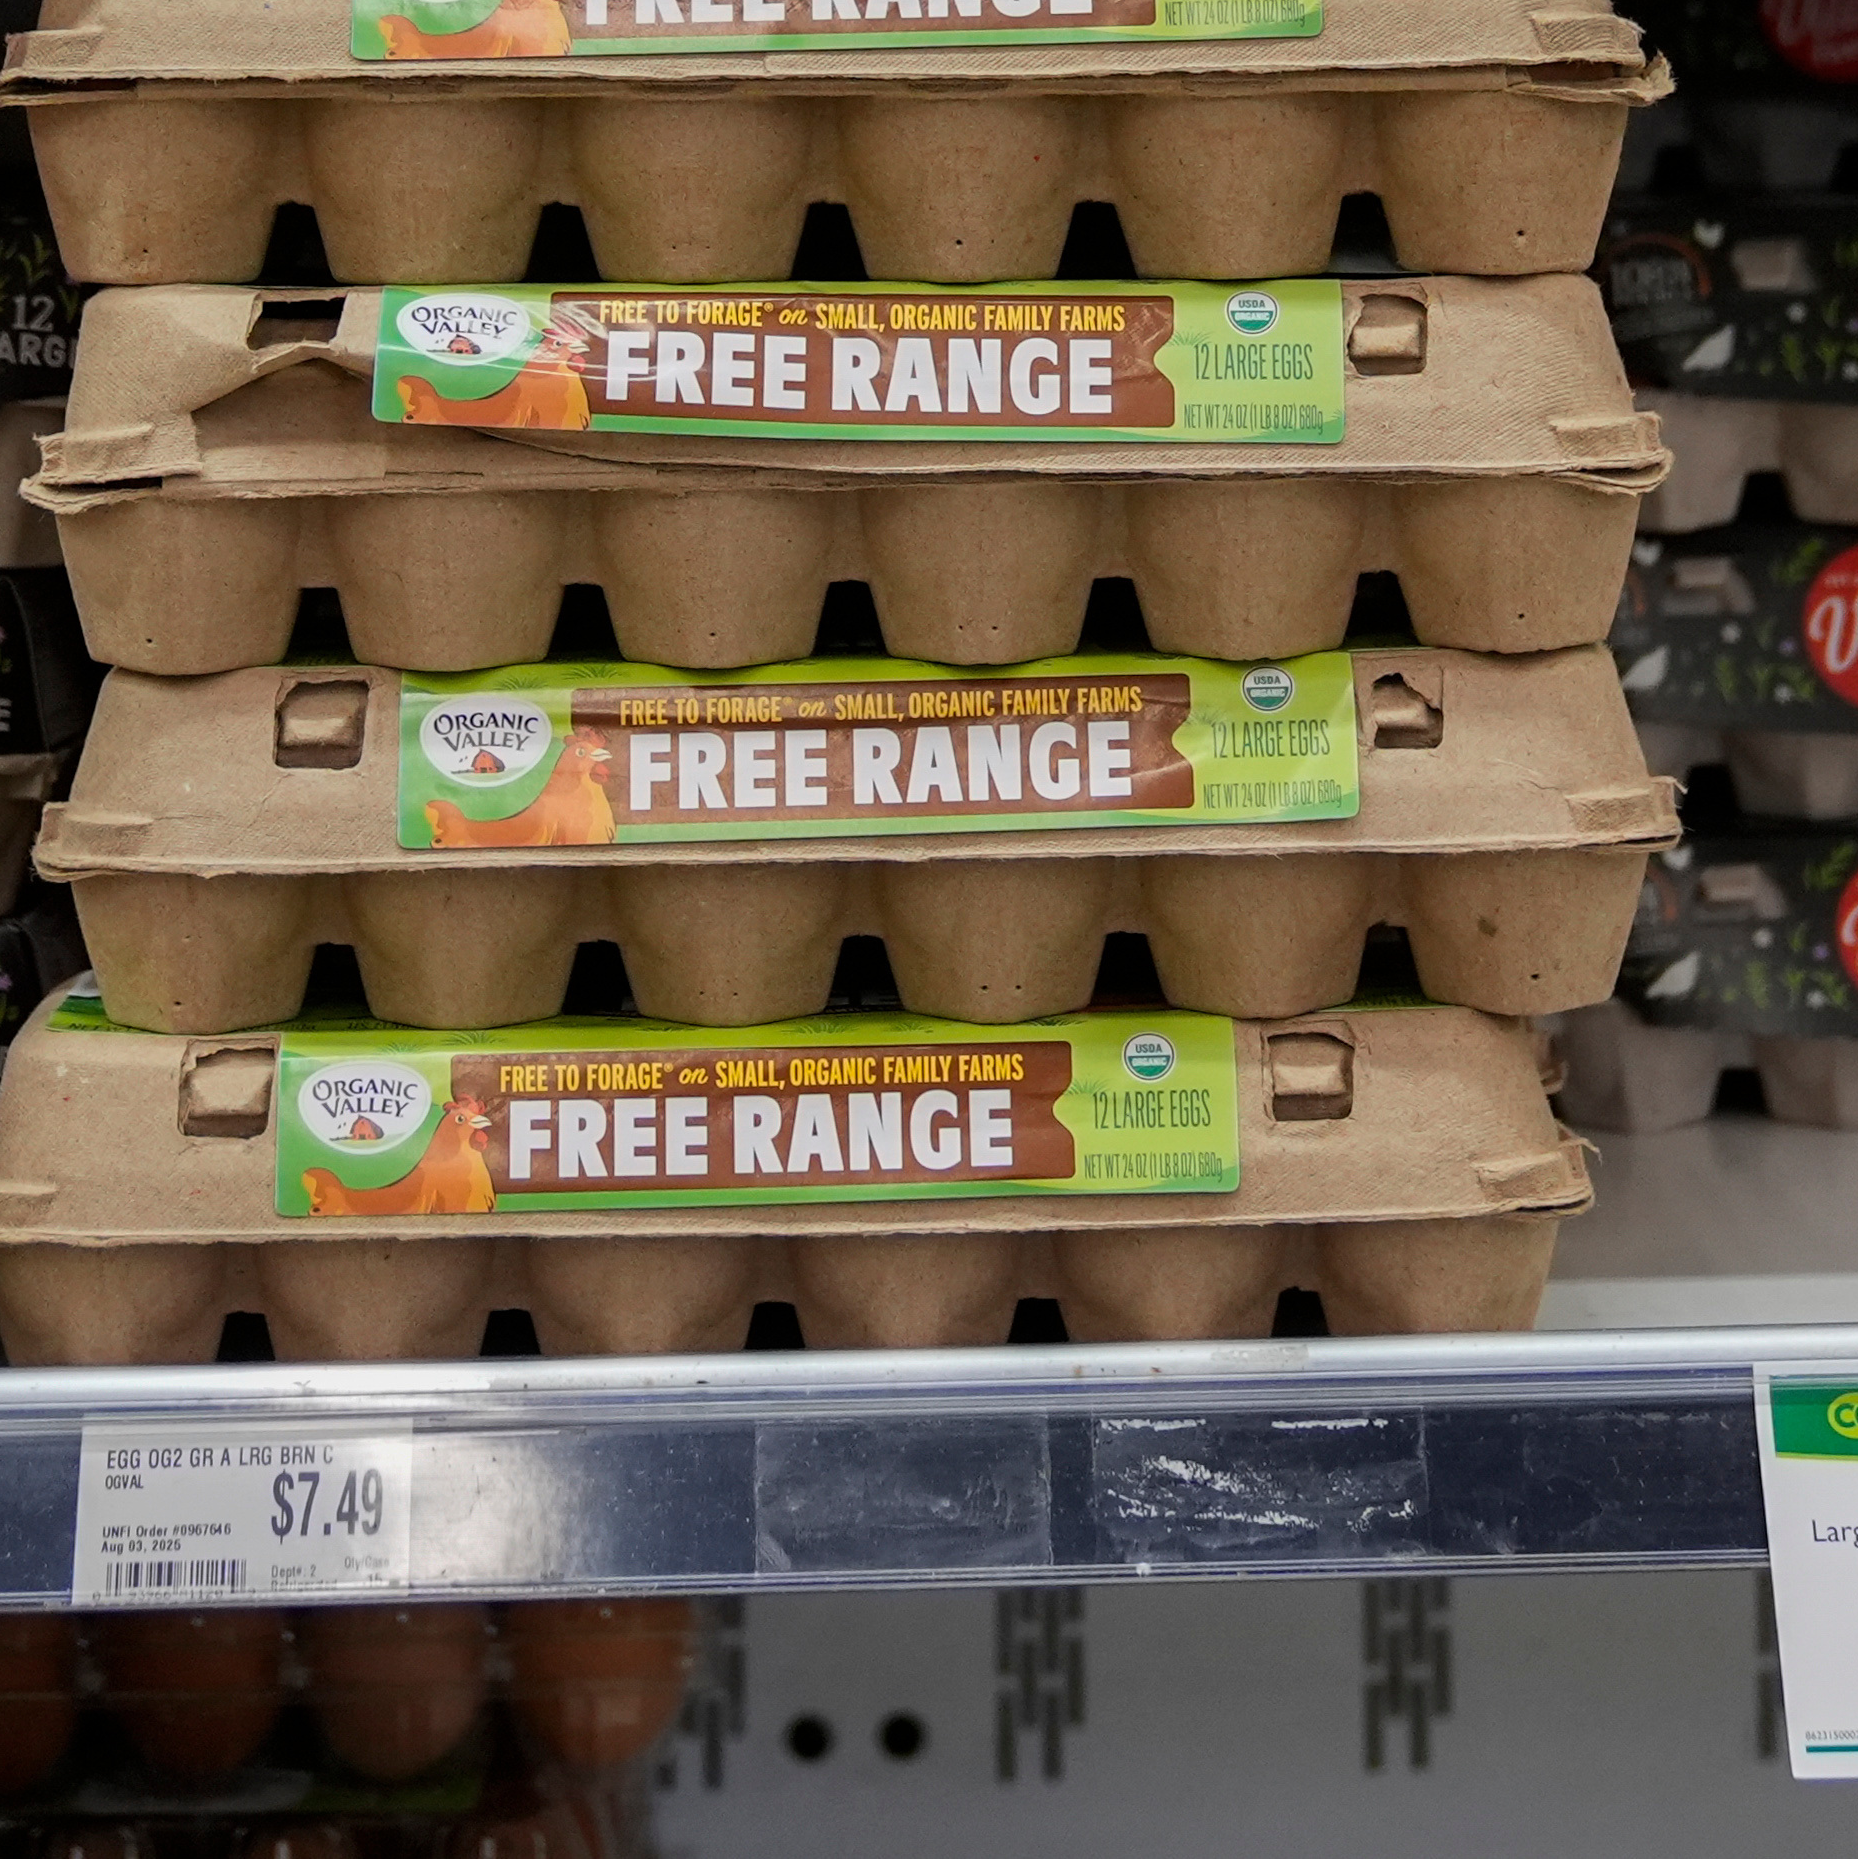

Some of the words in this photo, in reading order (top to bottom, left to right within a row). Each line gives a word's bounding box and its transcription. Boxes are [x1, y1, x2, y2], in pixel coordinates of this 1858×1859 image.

[815, 301, 886, 333] SMALL,
[890, 302, 980, 331] ORGANIC
[983, 302, 1055, 331] FAMILY
[1058, 302, 1125, 331] FARMS
[605, 331, 807, 409] FREE
[830, 337, 1114, 415] RANGE
[432, 713, 539, 744] ORGANIC
[444, 729, 531, 755] VALLEY
[627, 731, 831, 811] FREE
[852, 720, 1134, 805] RANGE
[507, 1101, 711, 1179] FREE
[733, 1089, 1013, 1175] RANGE
[107, 1449, 141, 1470] EGG
[239, 1446, 273, 1466] LRG
[280, 1445, 316, 1465] BRN
[271, 1468, 383, 1545] $7.49
